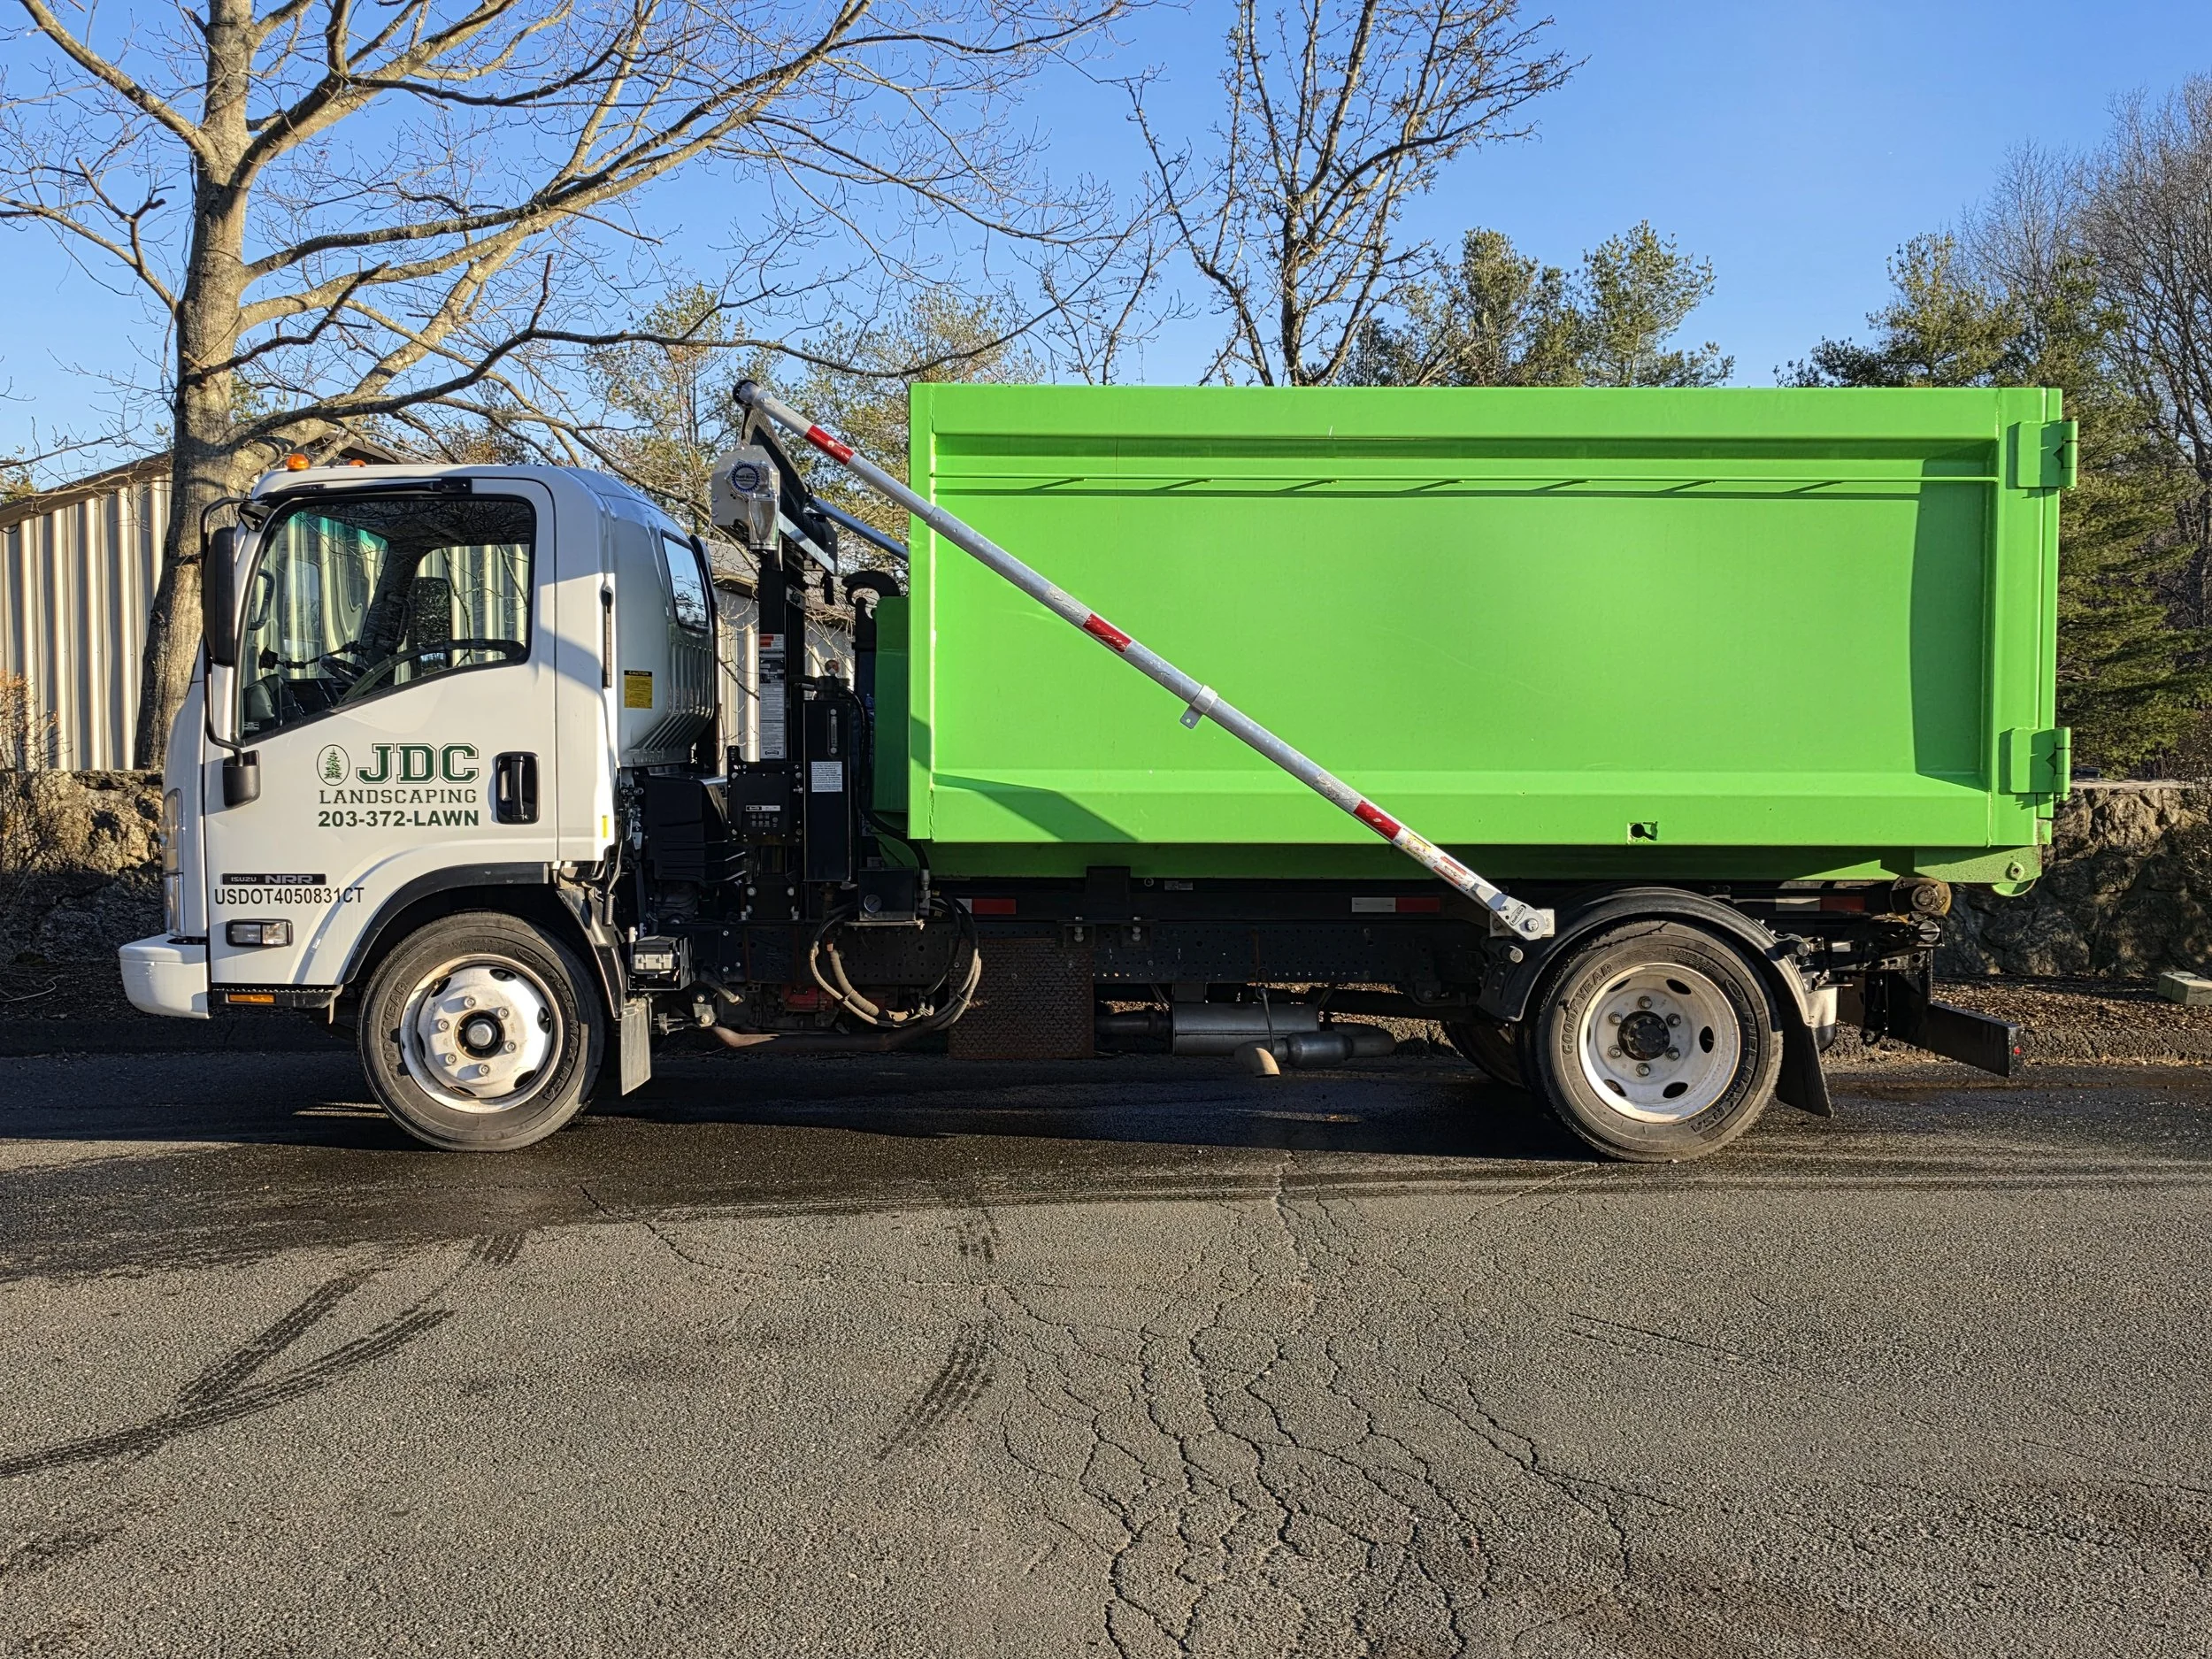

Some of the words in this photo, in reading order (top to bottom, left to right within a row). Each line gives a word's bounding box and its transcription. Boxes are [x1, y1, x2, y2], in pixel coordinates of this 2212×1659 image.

[356, 743, 480, 784] JDC
[319, 789, 477, 804] LANDSCAPING
[318, 810, 480, 827] 203-372-LAWN
[265, 875, 314, 885] NRR
[214, 887, 365, 905] USDOT4050831CT
[546, 970, 575, 1014] FUEL
[566, 1018, 580, 1063] MAX
[1562, 962, 1614, 1055] GOODYEAR
